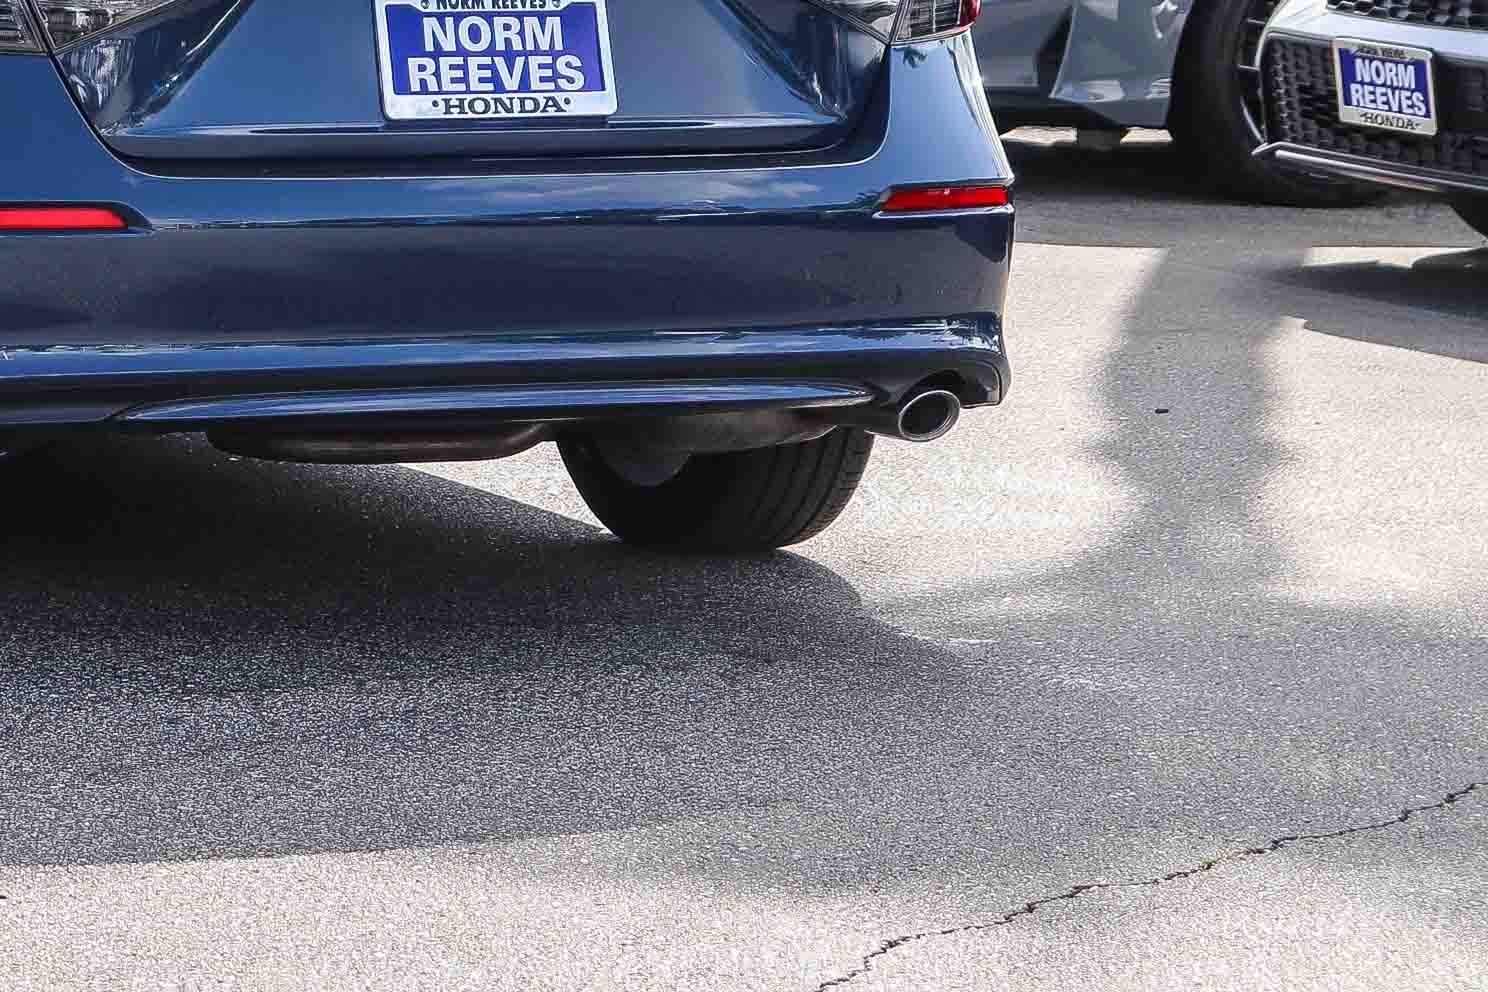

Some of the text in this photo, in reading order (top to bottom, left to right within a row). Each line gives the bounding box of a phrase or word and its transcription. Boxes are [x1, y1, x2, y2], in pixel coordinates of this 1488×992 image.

[422, 15, 564, 53] NORM
[407, 54, 586, 93] REEVES
[1354, 58, 1416, 89] NORM
[441, 95, 568, 116] HONDA
[1349, 83, 1427, 116] REEVES
